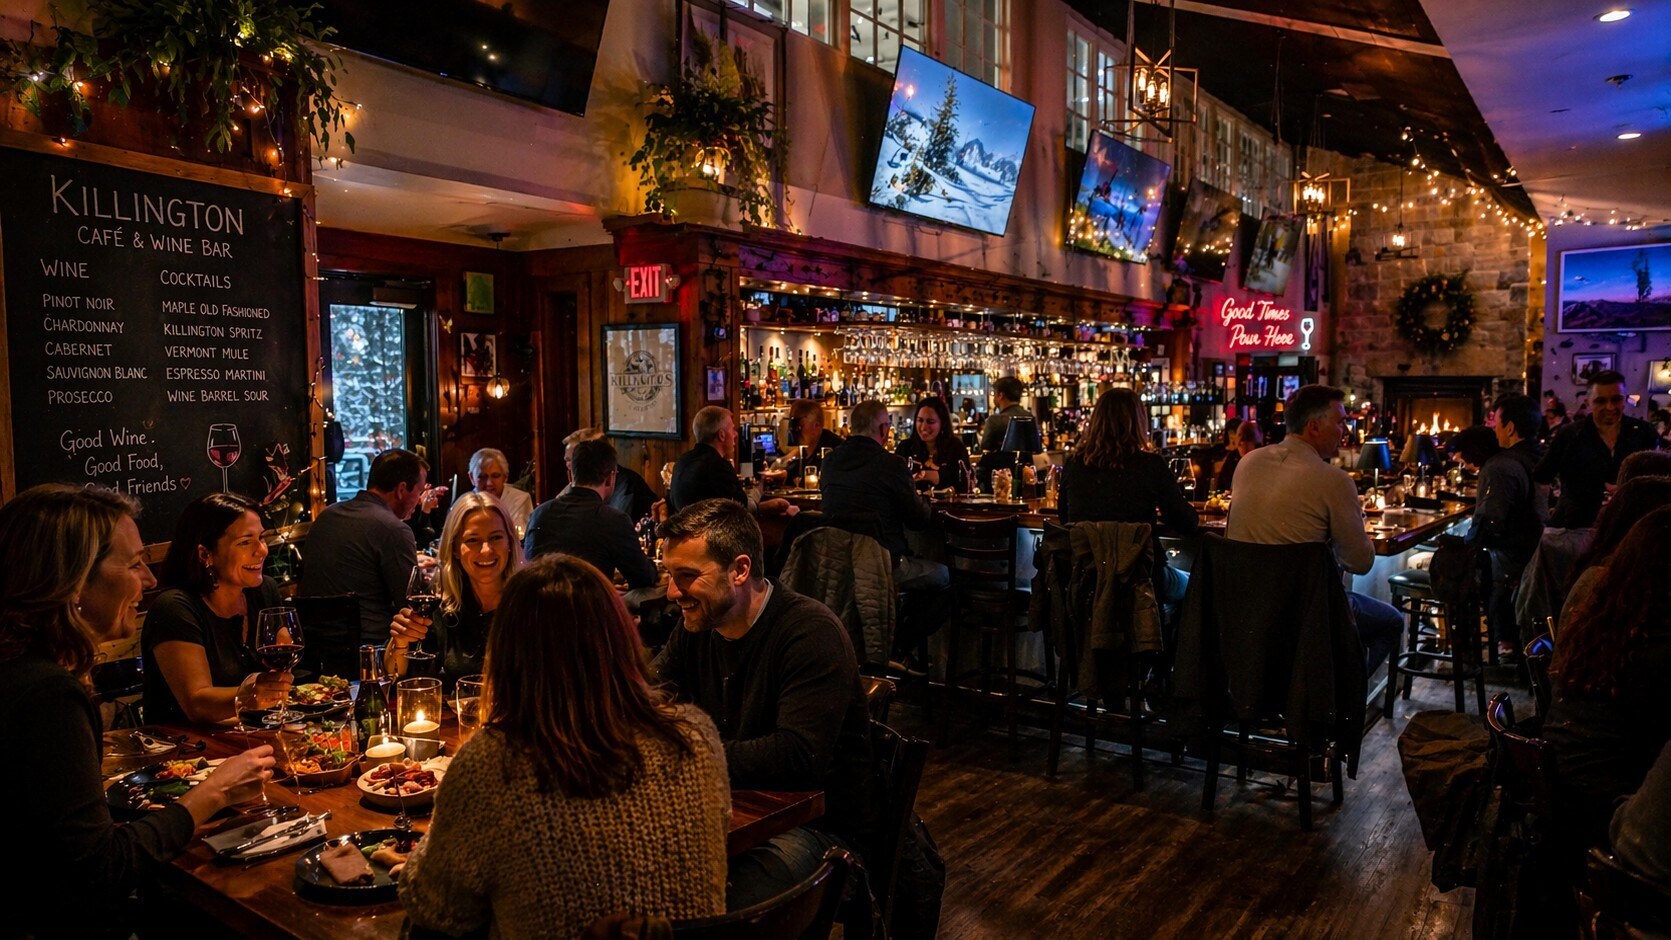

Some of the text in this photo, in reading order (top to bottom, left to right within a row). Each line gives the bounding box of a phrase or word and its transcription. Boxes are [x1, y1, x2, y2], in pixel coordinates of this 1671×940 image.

[50, 174, 244, 235] KILLINGTON
[77, 226, 233, 259] CAFÉ & WINE BAR
[40, 258, 90, 279] WINE
[160, 269, 232, 289] COCKTAILS
[630, 265, 662, 299] EXIT
[42, 293, 116, 311] PINOT NOIR
[162, 300, 271, 319] MAPLE OLD FASHIONED
[1221, 297, 1290, 327] Good Times
[43, 317, 125, 334] CHARDONNAY
[163, 323, 263, 340] KILLINGTON SPRITZ
[44, 341, 113, 356] CABERNET
[164, 345, 250, 360] VERMONT MULE
[46, 365, 148, 380] SAUVIGNON BLANC
[166, 367, 266, 381] ESPRESSO MARTINI
[47, 389, 113, 405] PROSECCO
[167, 389, 270, 403] WINE BARREL SOUR
[60, 429, 103, 453] Good
[84, 452, 163, 477] Good Food,
[84, 475, 177, 495] od Friends
